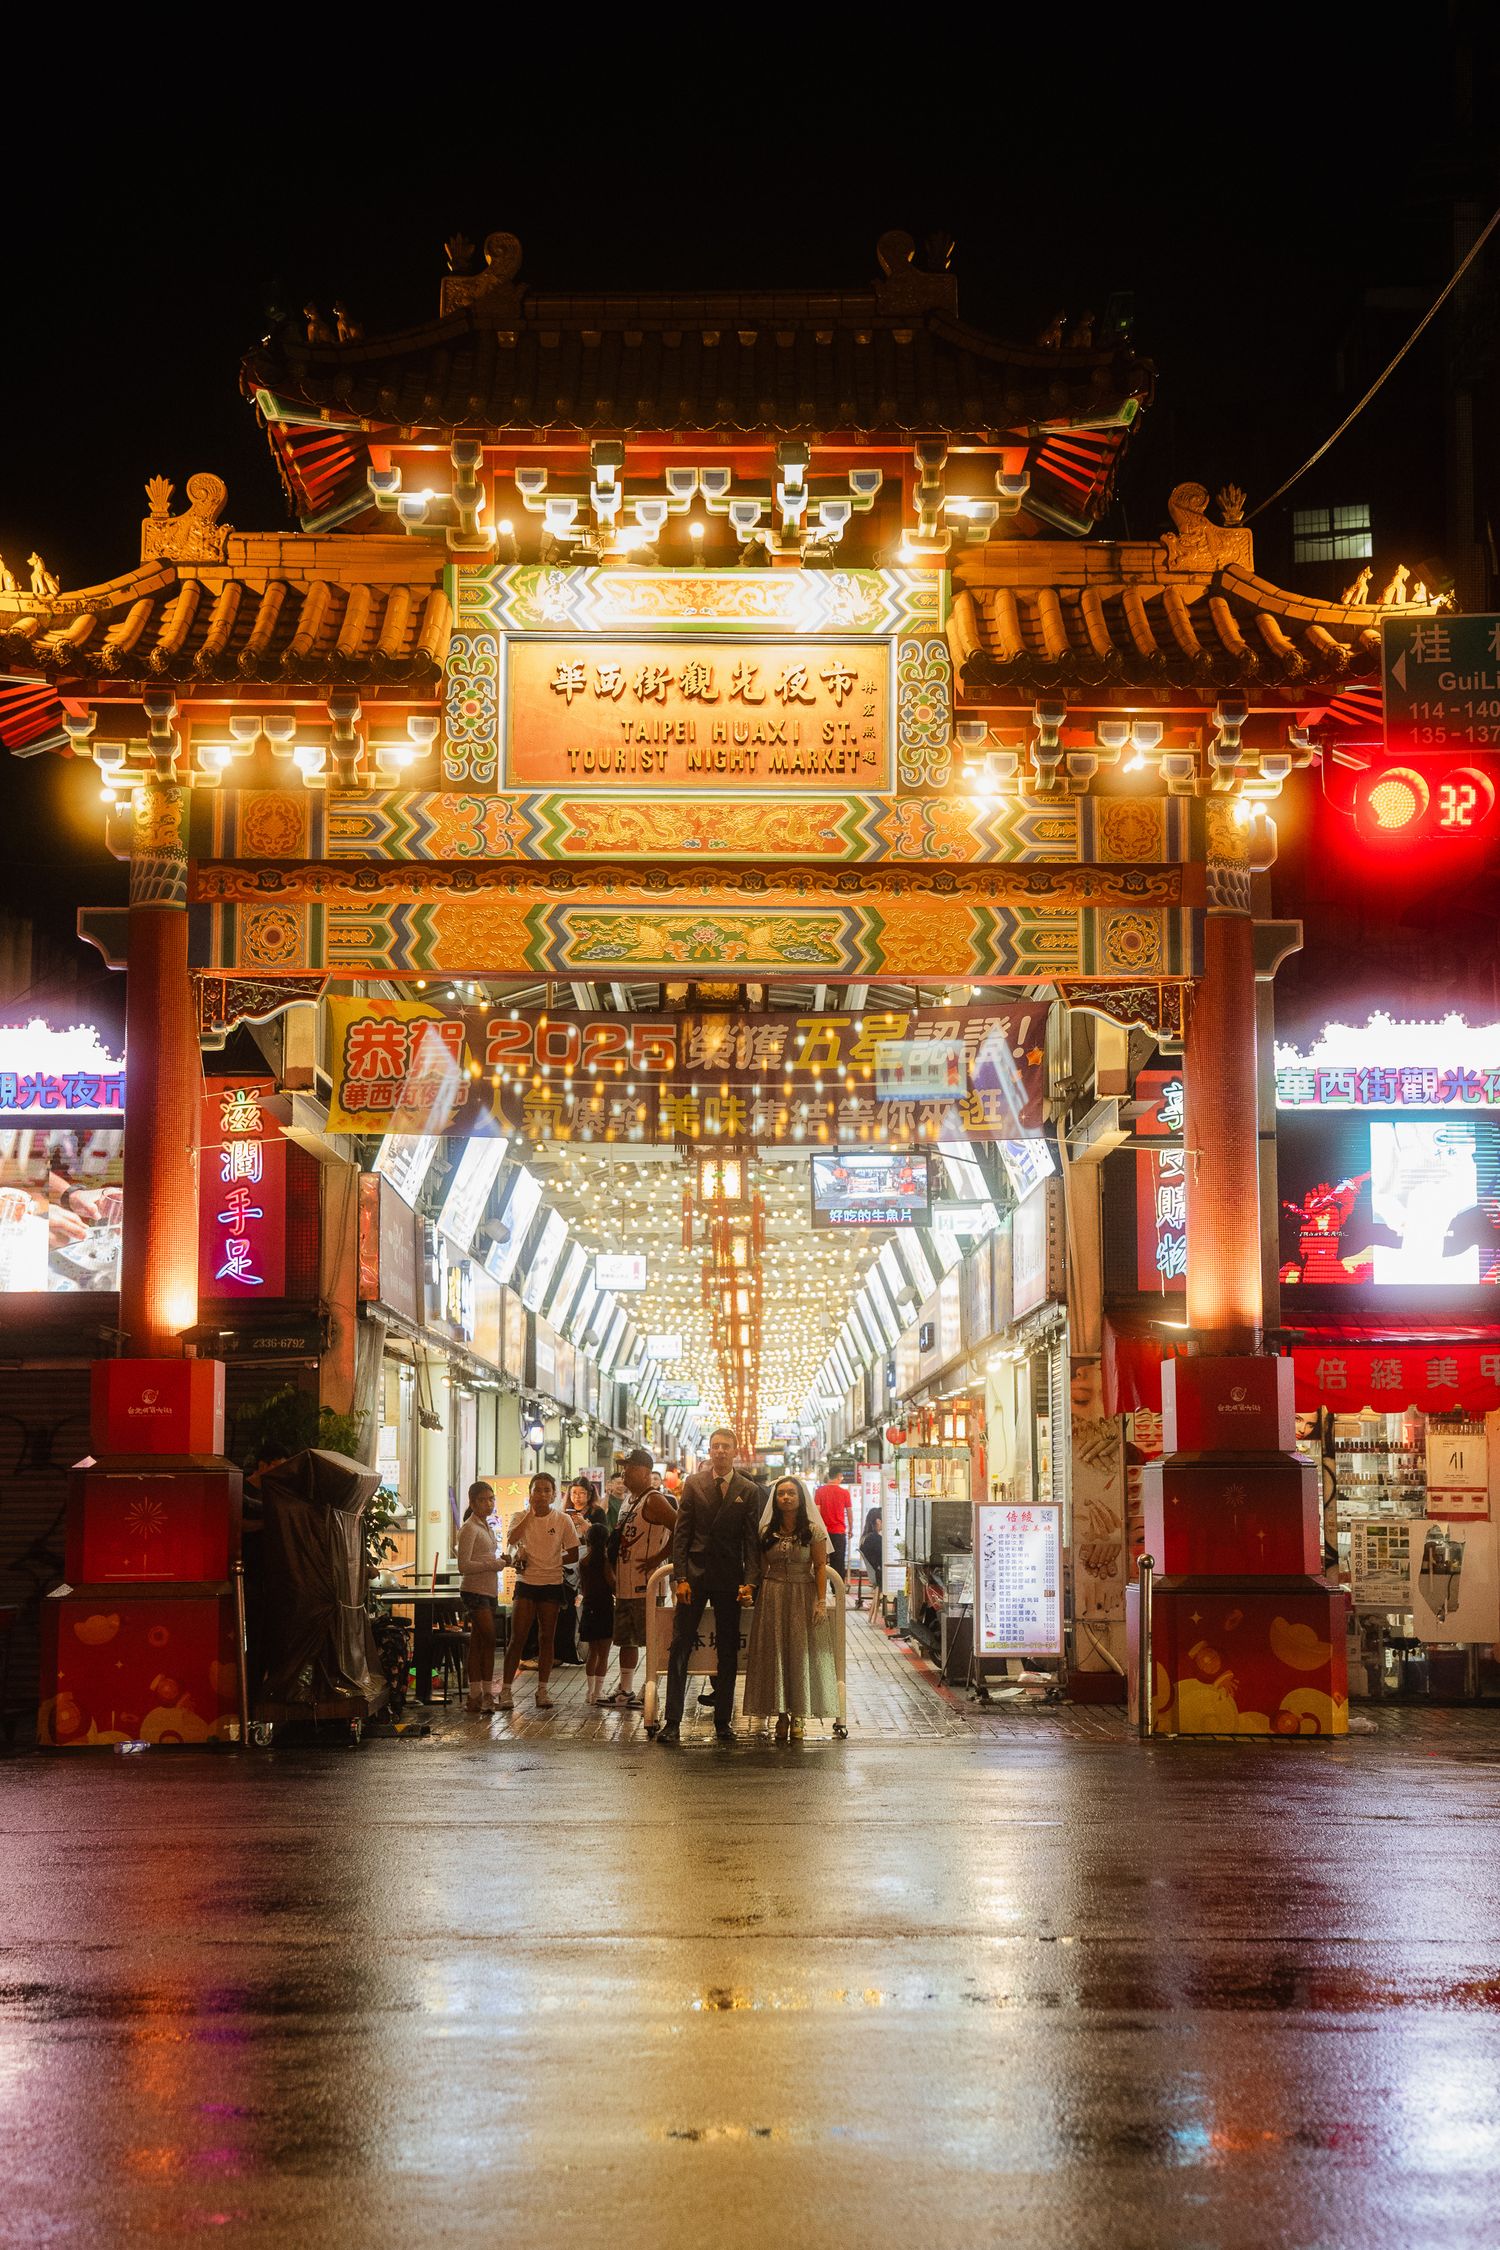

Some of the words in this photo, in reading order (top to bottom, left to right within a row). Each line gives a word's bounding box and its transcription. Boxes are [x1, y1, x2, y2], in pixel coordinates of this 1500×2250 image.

[549, 659, 860, 706] 華西街觀光夜市
[621, 719, 696, 745] TAIPEI
[712, 719, 801, 745] HUAXI
[822, 719, 858, 745] ST.
[567, 746, 669, 774] TOURIST
[687, 746, 760, 774] NIGHT
[768, 746, 860, 774] MARKET
[349, 1020, 466, 1080] 恭賀
[343, 1082, 470, 1110] 華西街夜市
[215, 1088, 264, 1285] 滋潤手足
[829, 1209, 912, 1223] 好吃的生魚片
[625, 1525, 637, 1538] 23
